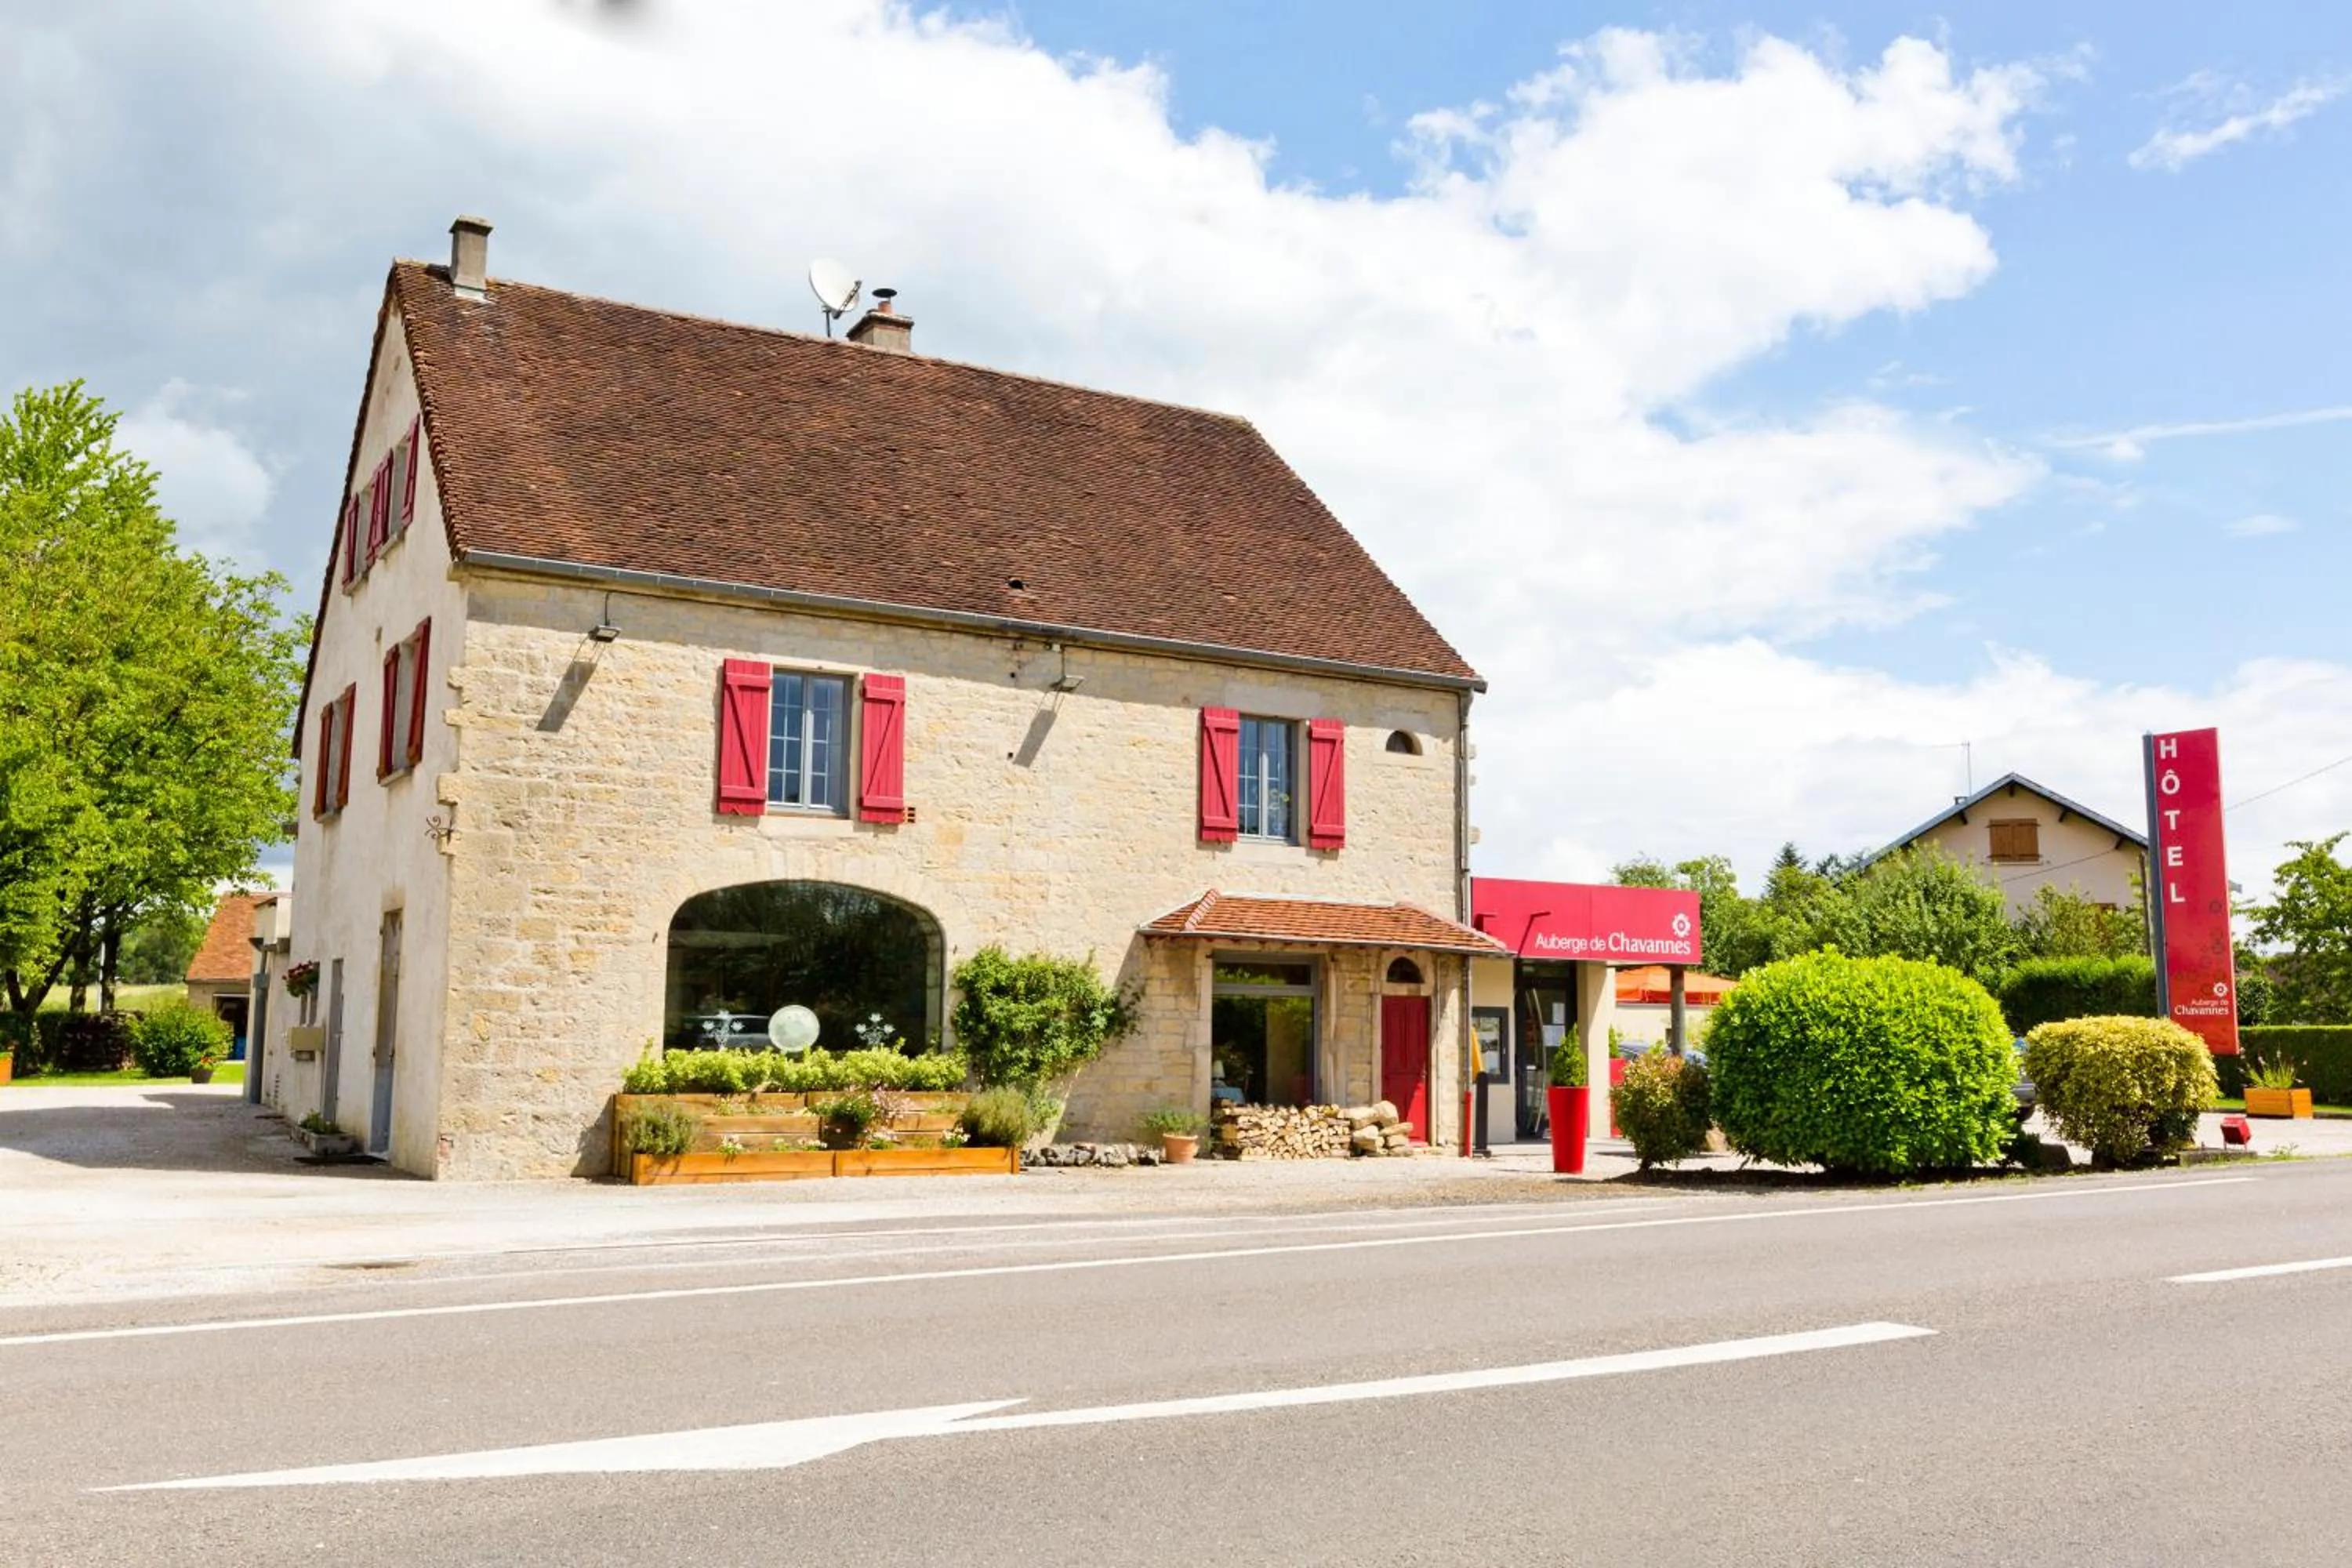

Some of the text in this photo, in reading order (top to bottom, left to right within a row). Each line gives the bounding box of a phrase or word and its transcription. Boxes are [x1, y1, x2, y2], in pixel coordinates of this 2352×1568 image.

[2159, 738, 2185, 903] HÔTEL
[1535, 931, 1691, 954] Auberge de Chavannes
[2174, 1004, 2229, 1015] Chavannes
